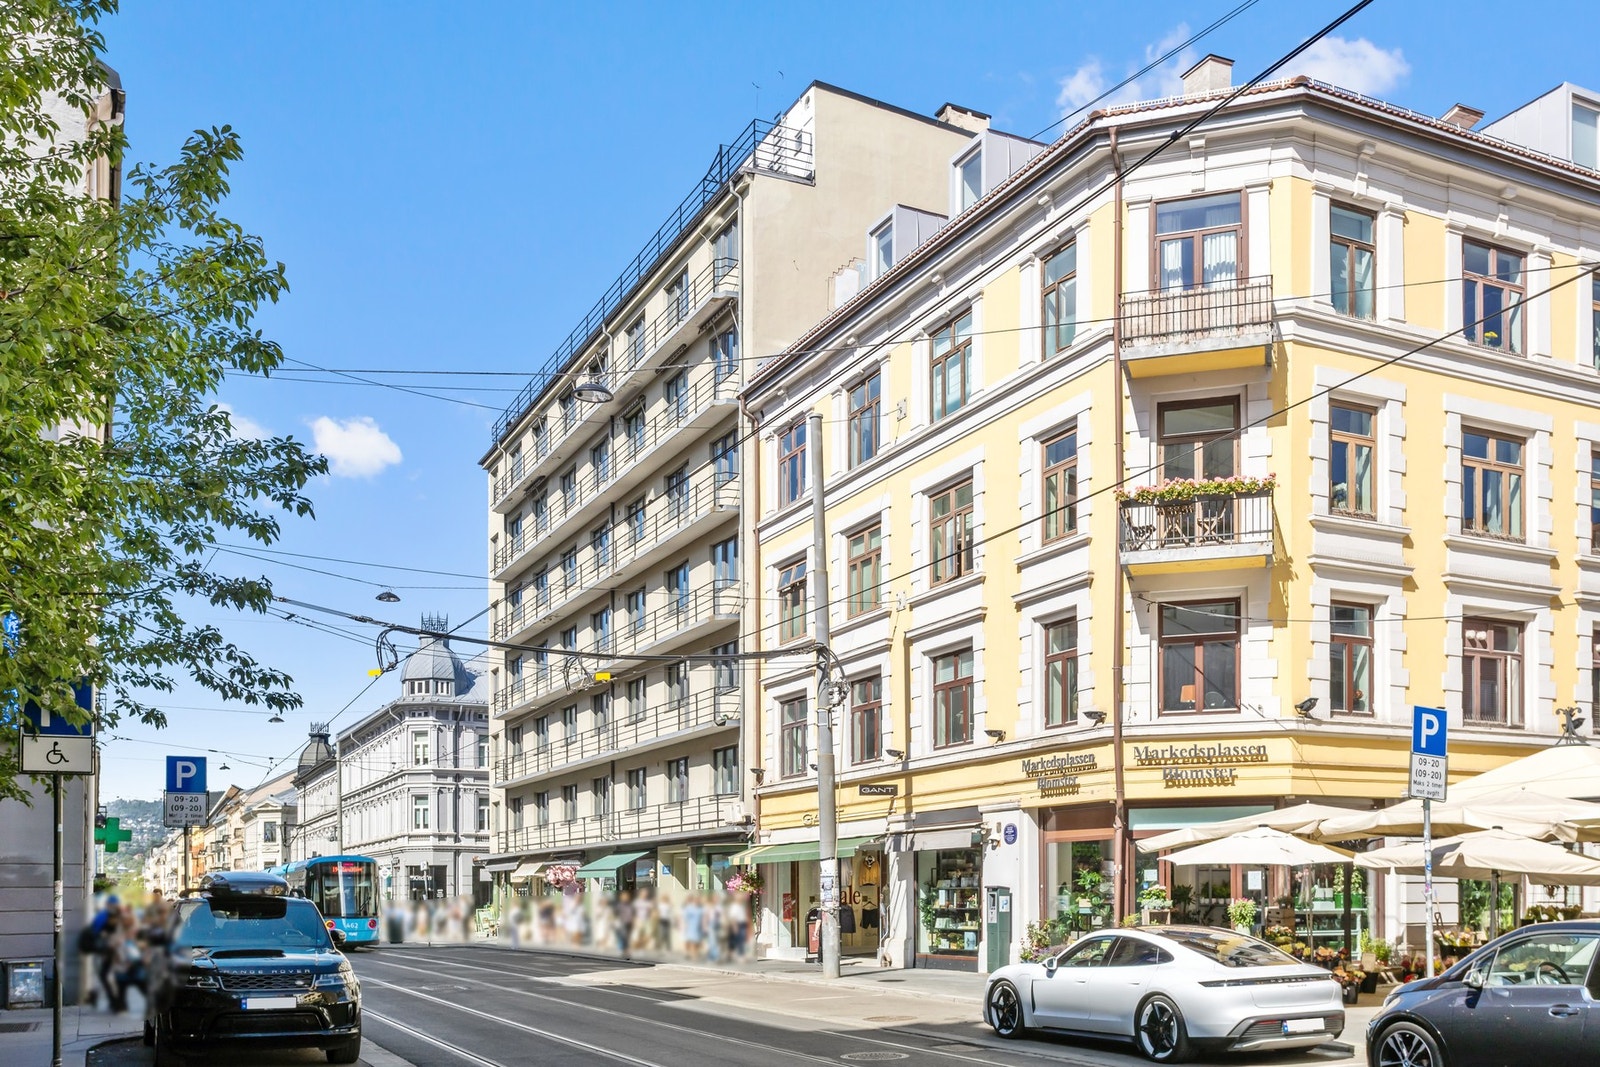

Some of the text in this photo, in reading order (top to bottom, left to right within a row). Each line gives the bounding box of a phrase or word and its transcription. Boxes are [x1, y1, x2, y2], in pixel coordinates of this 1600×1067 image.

[1420, 713, 1440, 749] P
[1133, 743, 1267, 760] Markedsplassen
[1021, 753, 1096, 772] Markedsplassen
[176, 761, 197, 789] P
[1037, 775, 1079, 790] Blomster
[1162, 766, 1237, 780] Blomster
[841, 884, 861, 905] ale
